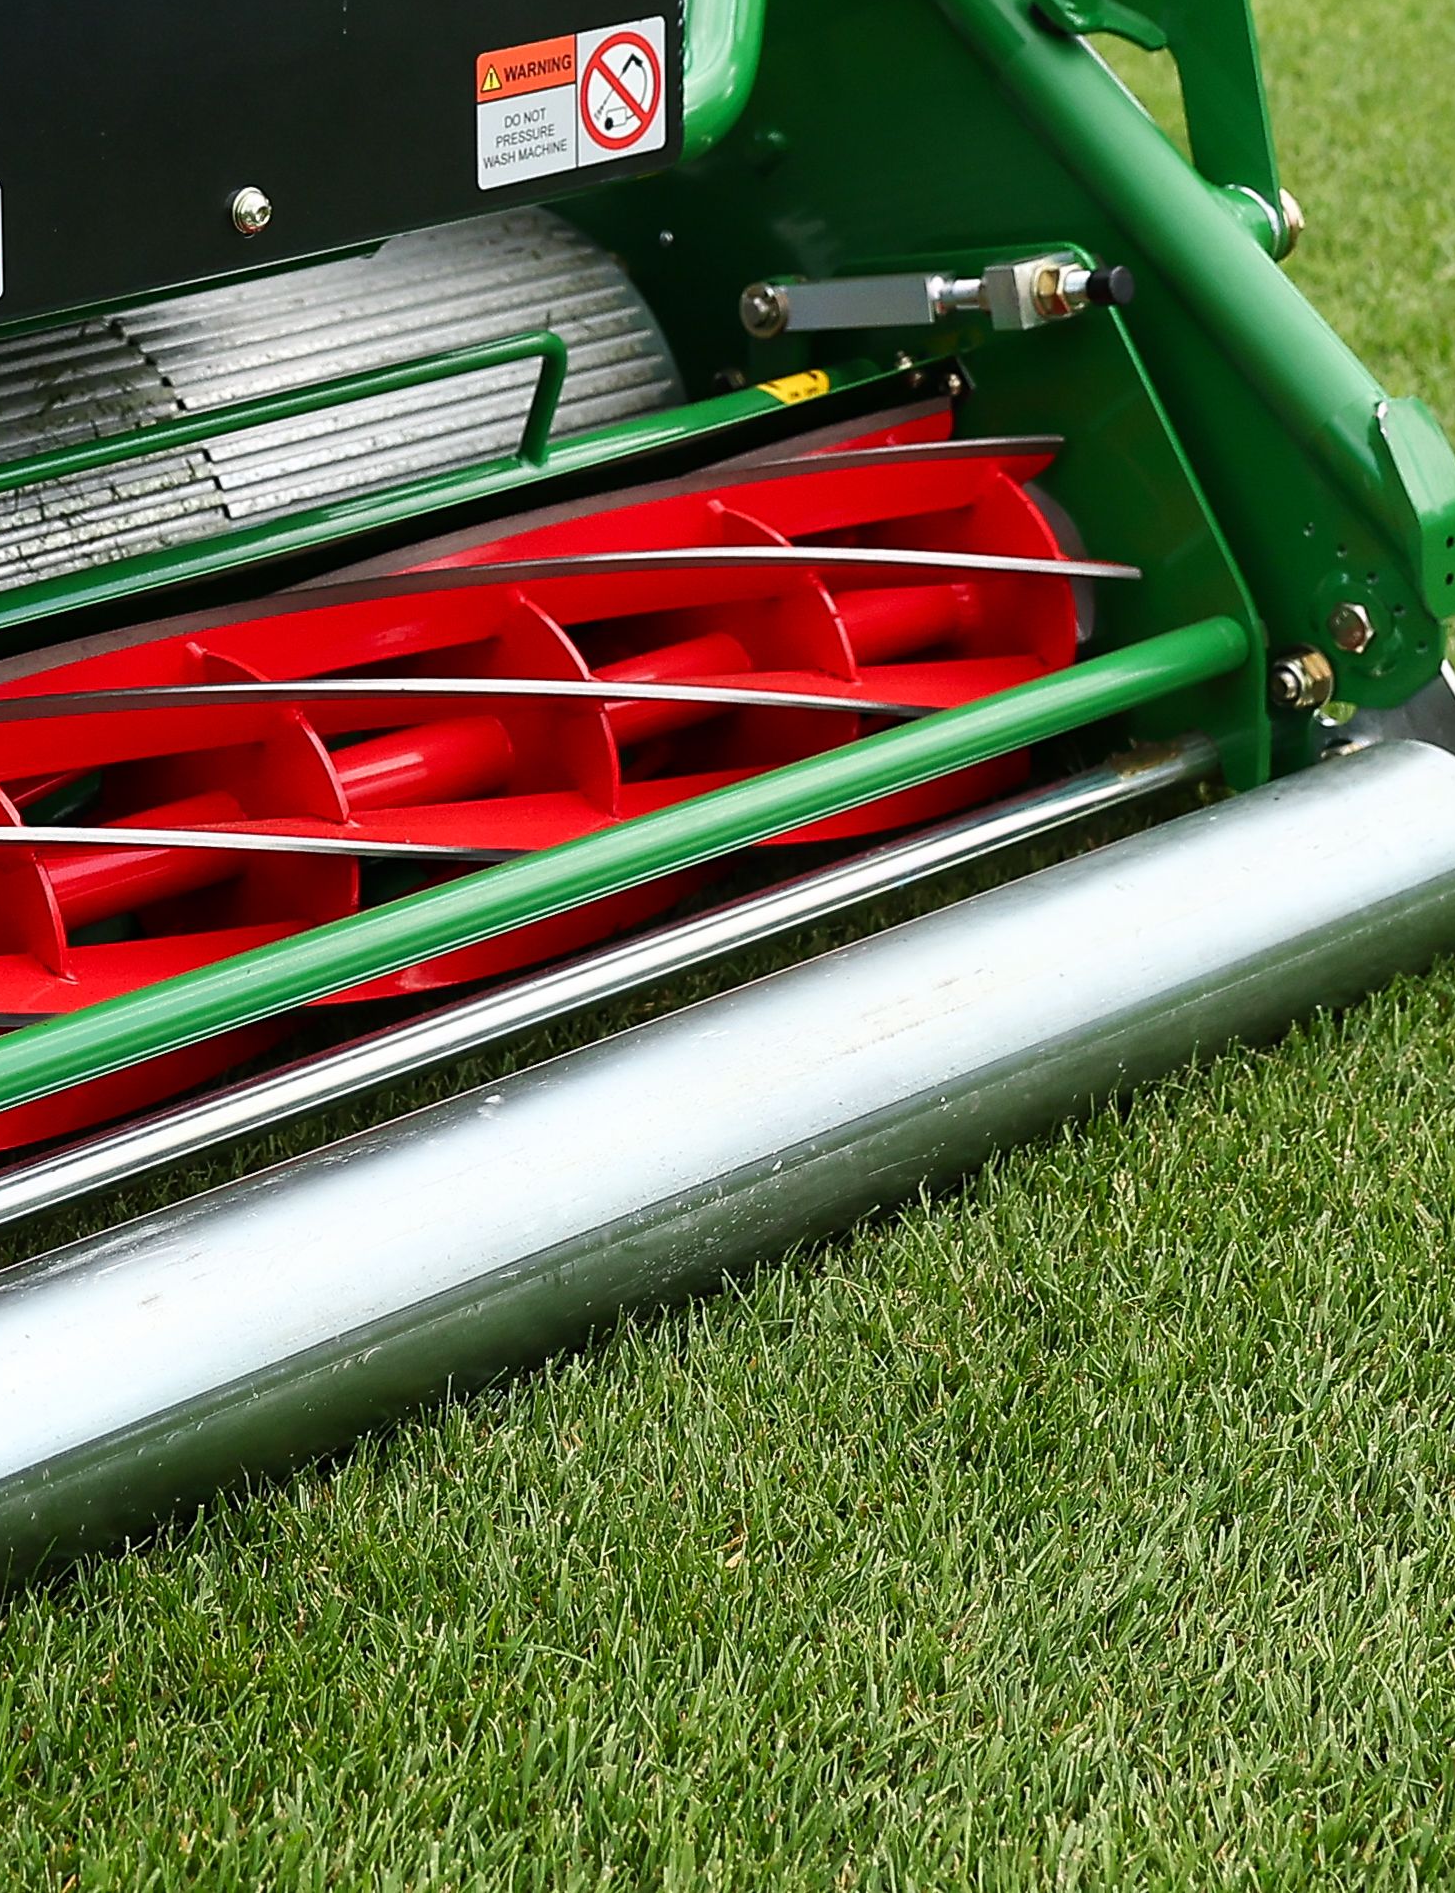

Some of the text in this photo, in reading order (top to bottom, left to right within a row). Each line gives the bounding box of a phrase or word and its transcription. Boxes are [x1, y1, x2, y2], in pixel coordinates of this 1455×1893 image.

[503, 54, 572, 82] WARNING
[504, 107, 547, 129] DO NOT
[495, 123, 556, 148] PRESSURE
[483, 138, 567, 170] WASH MACHINE
